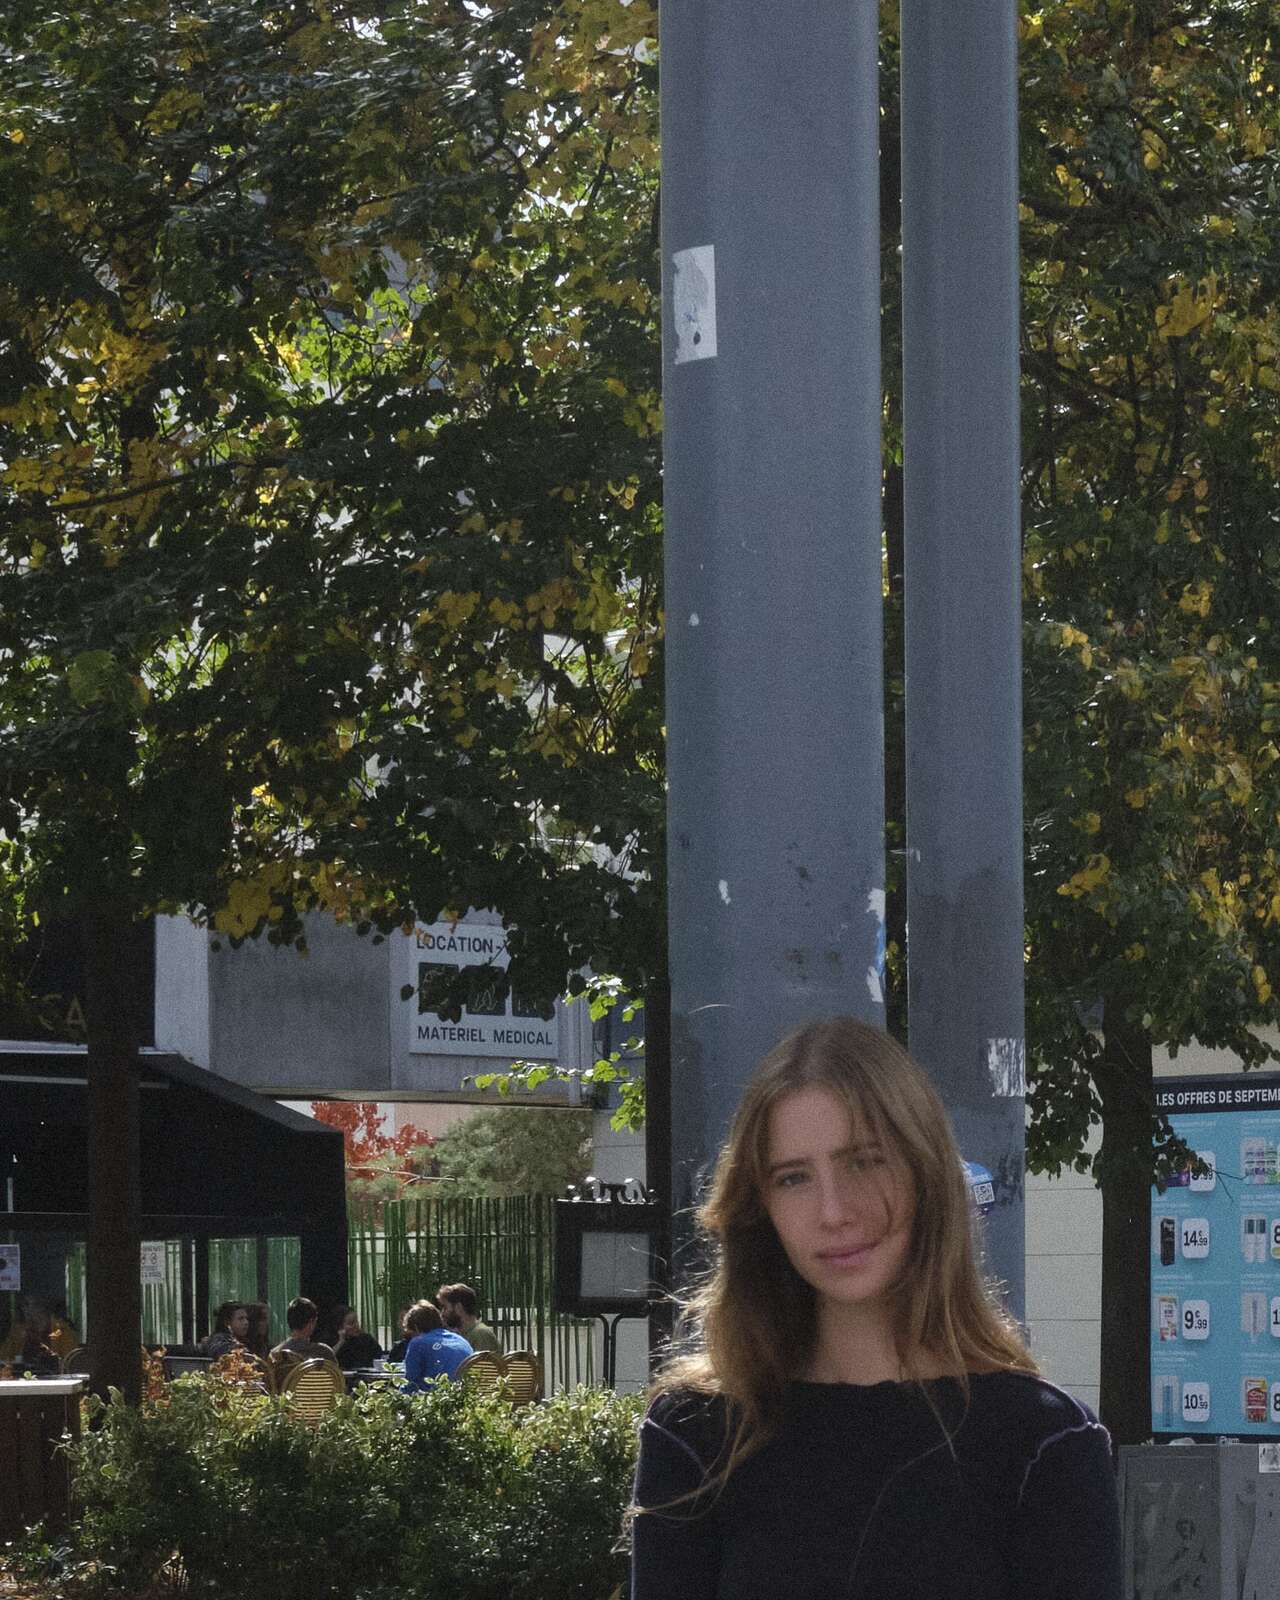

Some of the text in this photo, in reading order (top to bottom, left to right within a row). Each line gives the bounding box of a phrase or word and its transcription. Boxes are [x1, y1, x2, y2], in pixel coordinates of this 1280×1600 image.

[417, 1025, 553, 1046] MATERIEL MEDICAL
[1156, 1092, 1175, 1107] LES
[1176, 1091, 1216, 1106] OFFRES
[1218, 1090, 1233, 1104] DE
